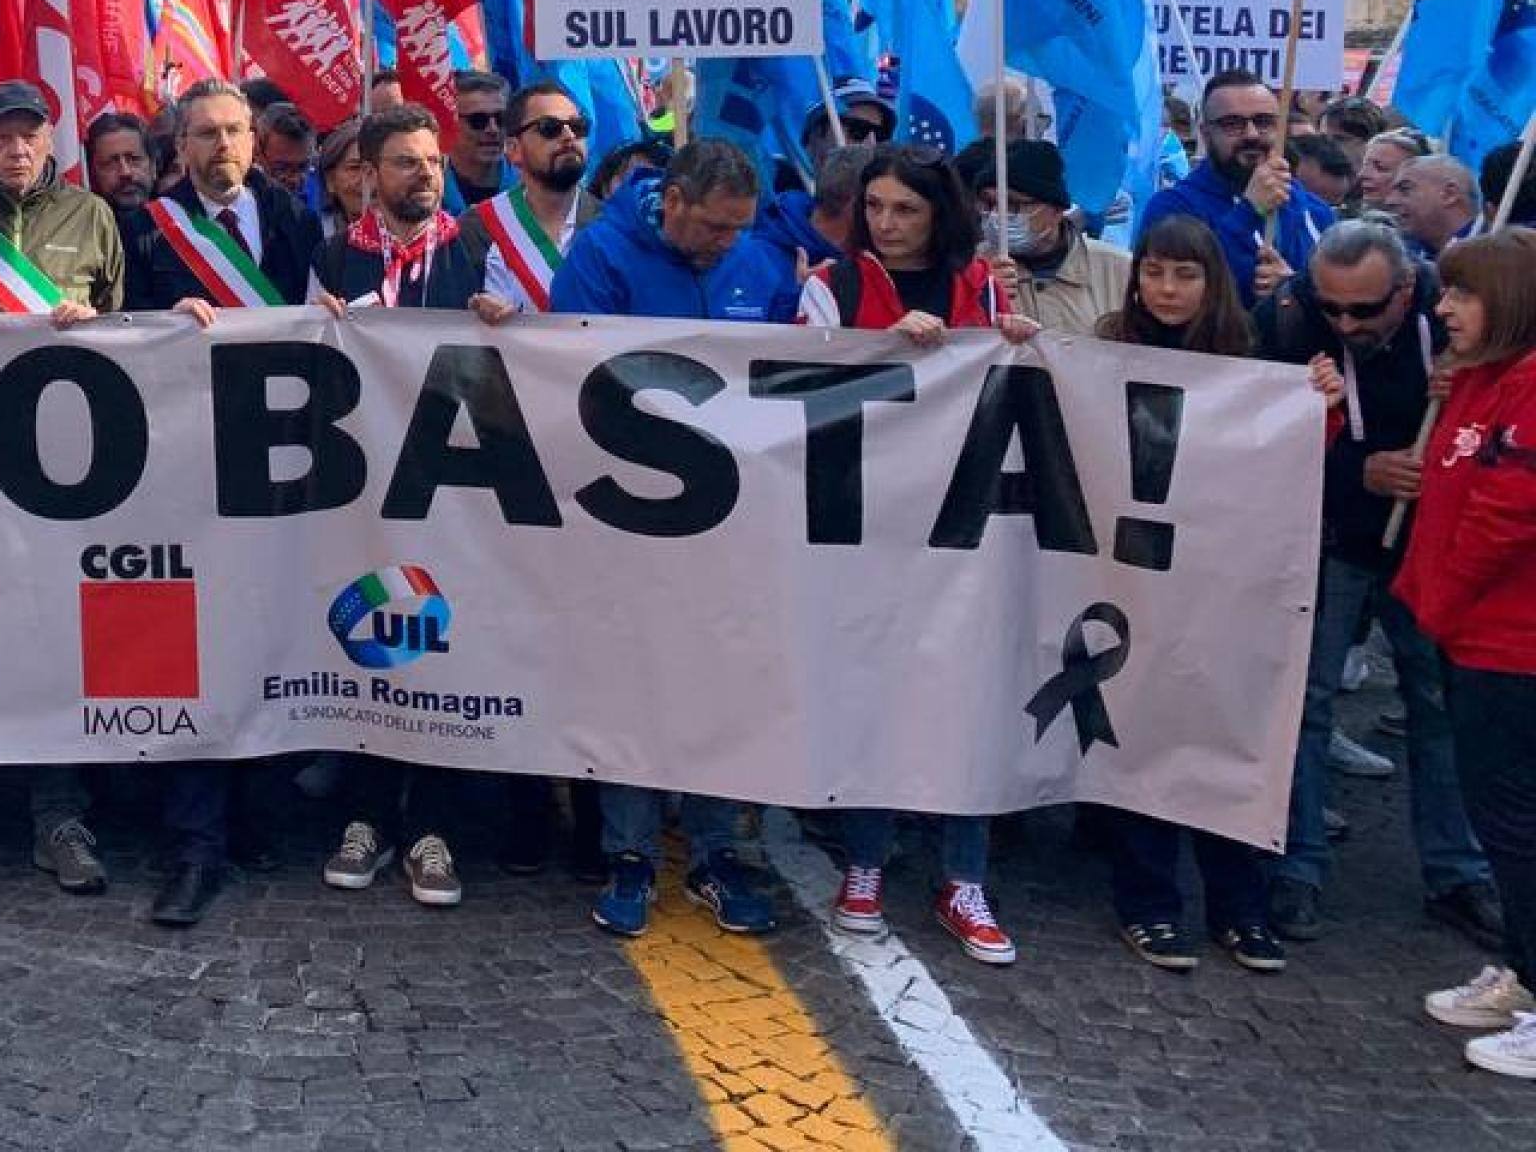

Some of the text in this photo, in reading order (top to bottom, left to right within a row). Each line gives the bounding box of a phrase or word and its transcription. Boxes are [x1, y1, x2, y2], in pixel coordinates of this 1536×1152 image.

[566, 7, 793, 49] SUL LAVORO
[1153, 4, 1326, 39] UTELA DEI
[210, 341, 1185, 572] BASTA!
[80, 544, 193, 579] CGIL
[371, 610, 450, 654] UIL
[263, 672, 524, 721] Emilia Romagna
[83, 705, 198, 735] IMOLA
[303, 706, 382, 726] SINDACATO
[384, 714, 425, 733] DELLE
[429, 722, 496, 740] PERSONE
